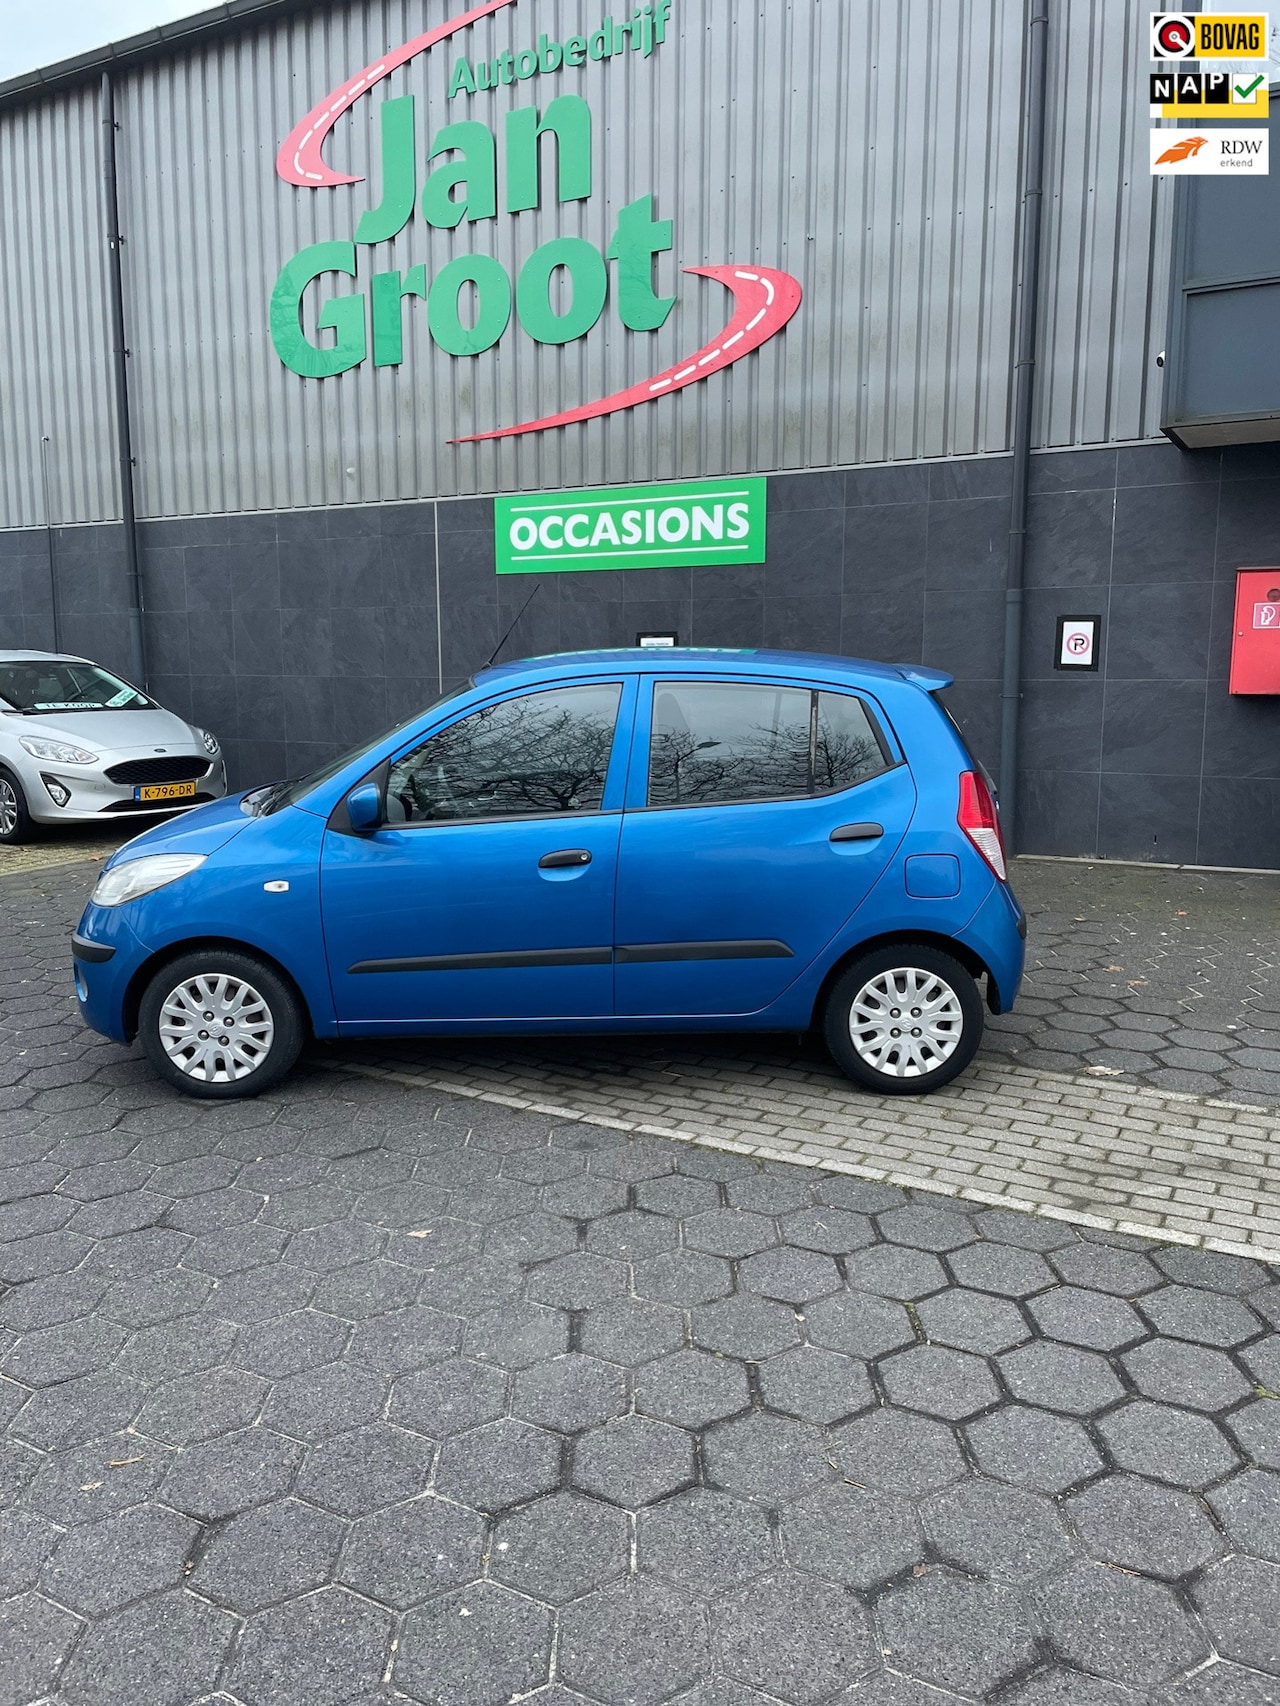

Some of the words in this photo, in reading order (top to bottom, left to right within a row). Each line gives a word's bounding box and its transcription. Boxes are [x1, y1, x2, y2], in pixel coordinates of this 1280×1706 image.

[447, 0, 672, 99] Autobedrijf
[354, 94, 592, 245] Jan
[270, 193, 678, 378] Groot
[509, 503, 749, 550] OCCASIONS
[144, 784, 192, 798] K-796-DR
